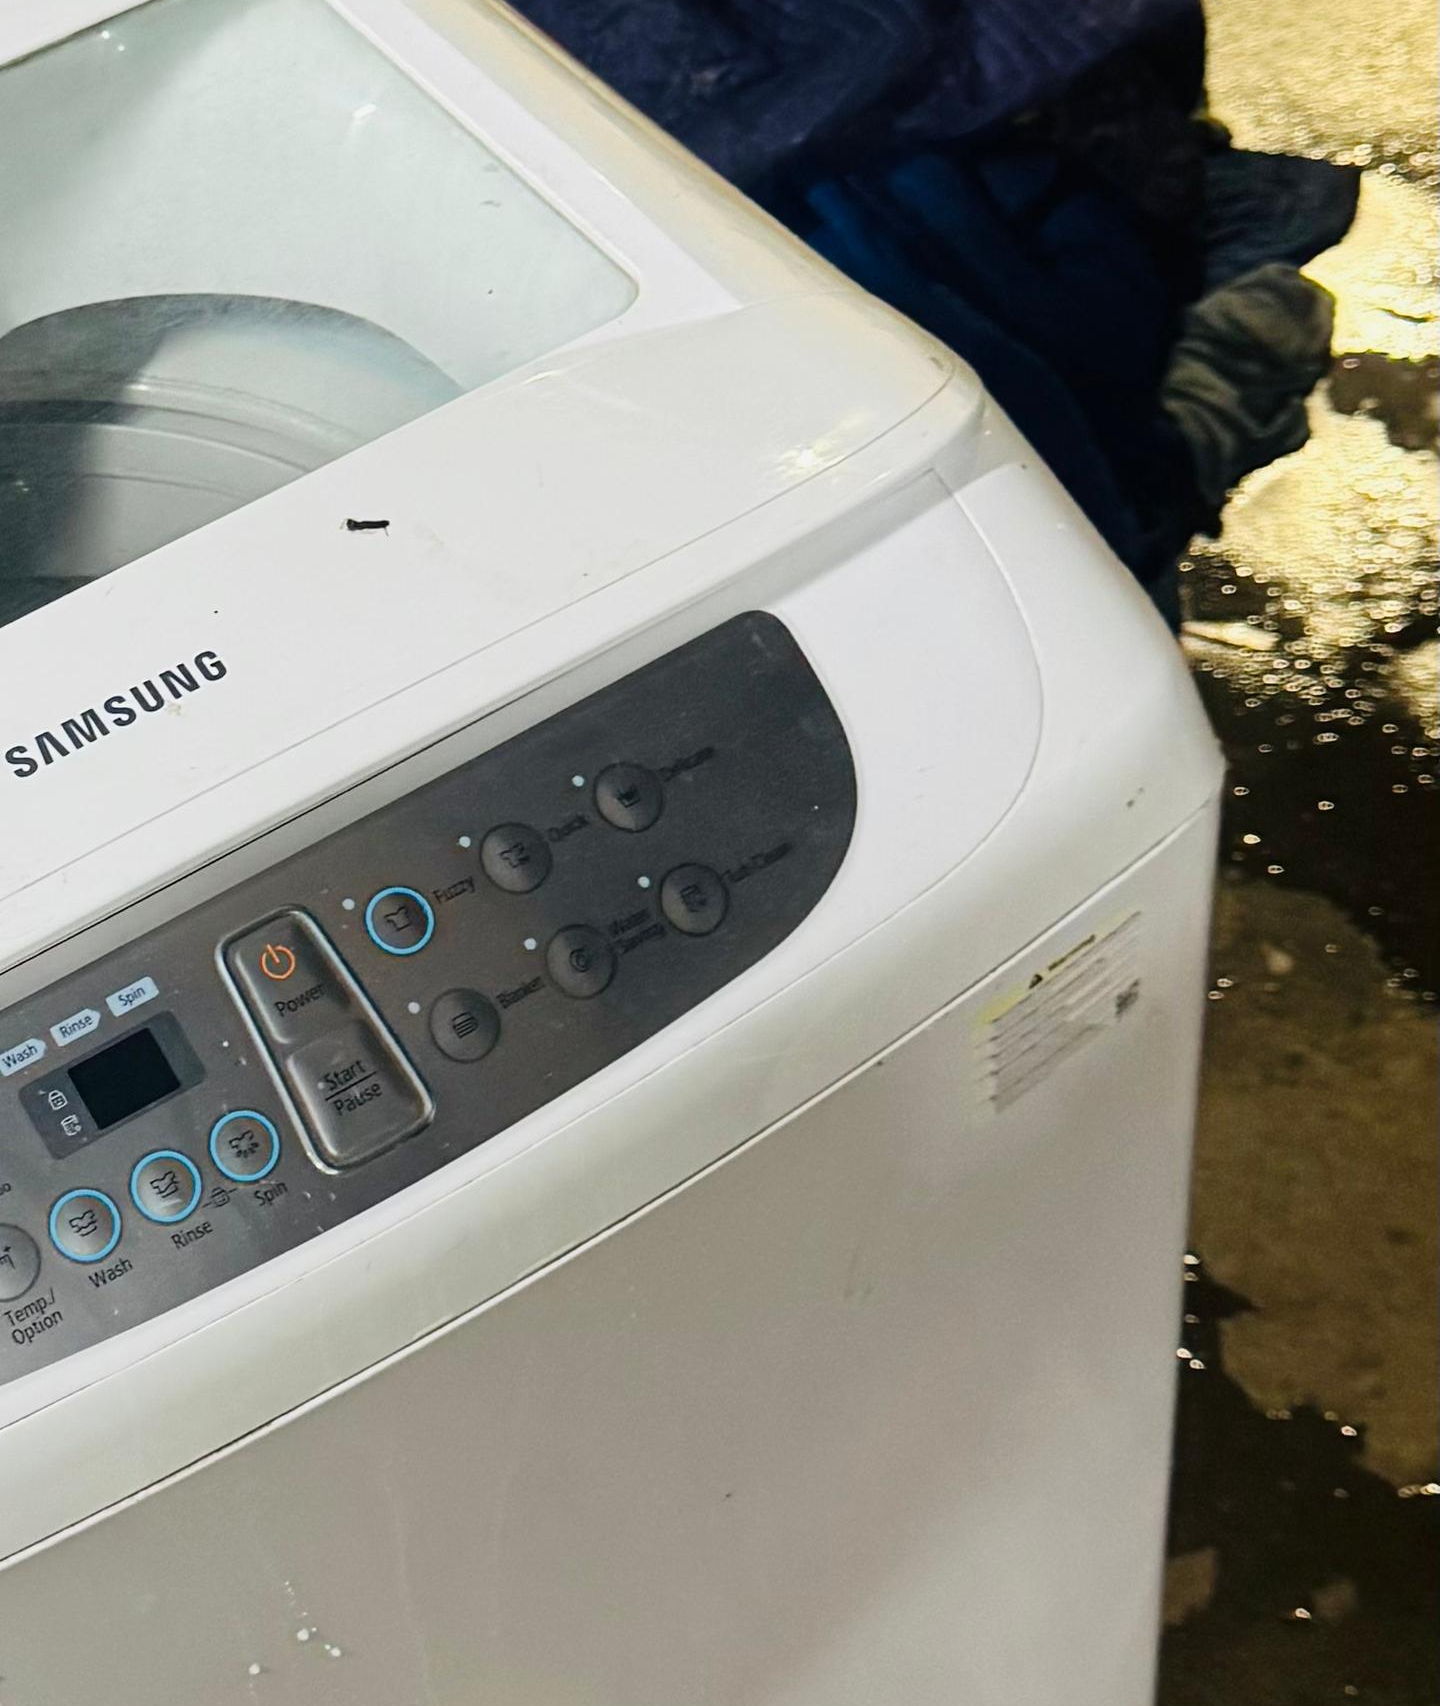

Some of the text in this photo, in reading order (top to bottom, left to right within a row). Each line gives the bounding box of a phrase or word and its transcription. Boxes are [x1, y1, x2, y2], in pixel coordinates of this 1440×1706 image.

[4, 649, 229, 778] SAMSUNG
[433, 877, 475, 903] Fuzzy
[274, 982, 327, 1017] Power
[3, 985, 146, 1068] Wash Rinse Spin
[324, 1060, 367, 1091] Start
[333, 1082, 383, 1116] Pause
[255, 1180, 288, 1209] Spin
[172, 1220, 213, 1250] Rinse
[89, 1258, 133, 1289] Wash
[2, 1286, 56, 1327] Temp./
[11, 1309, 63, 1346] Option
